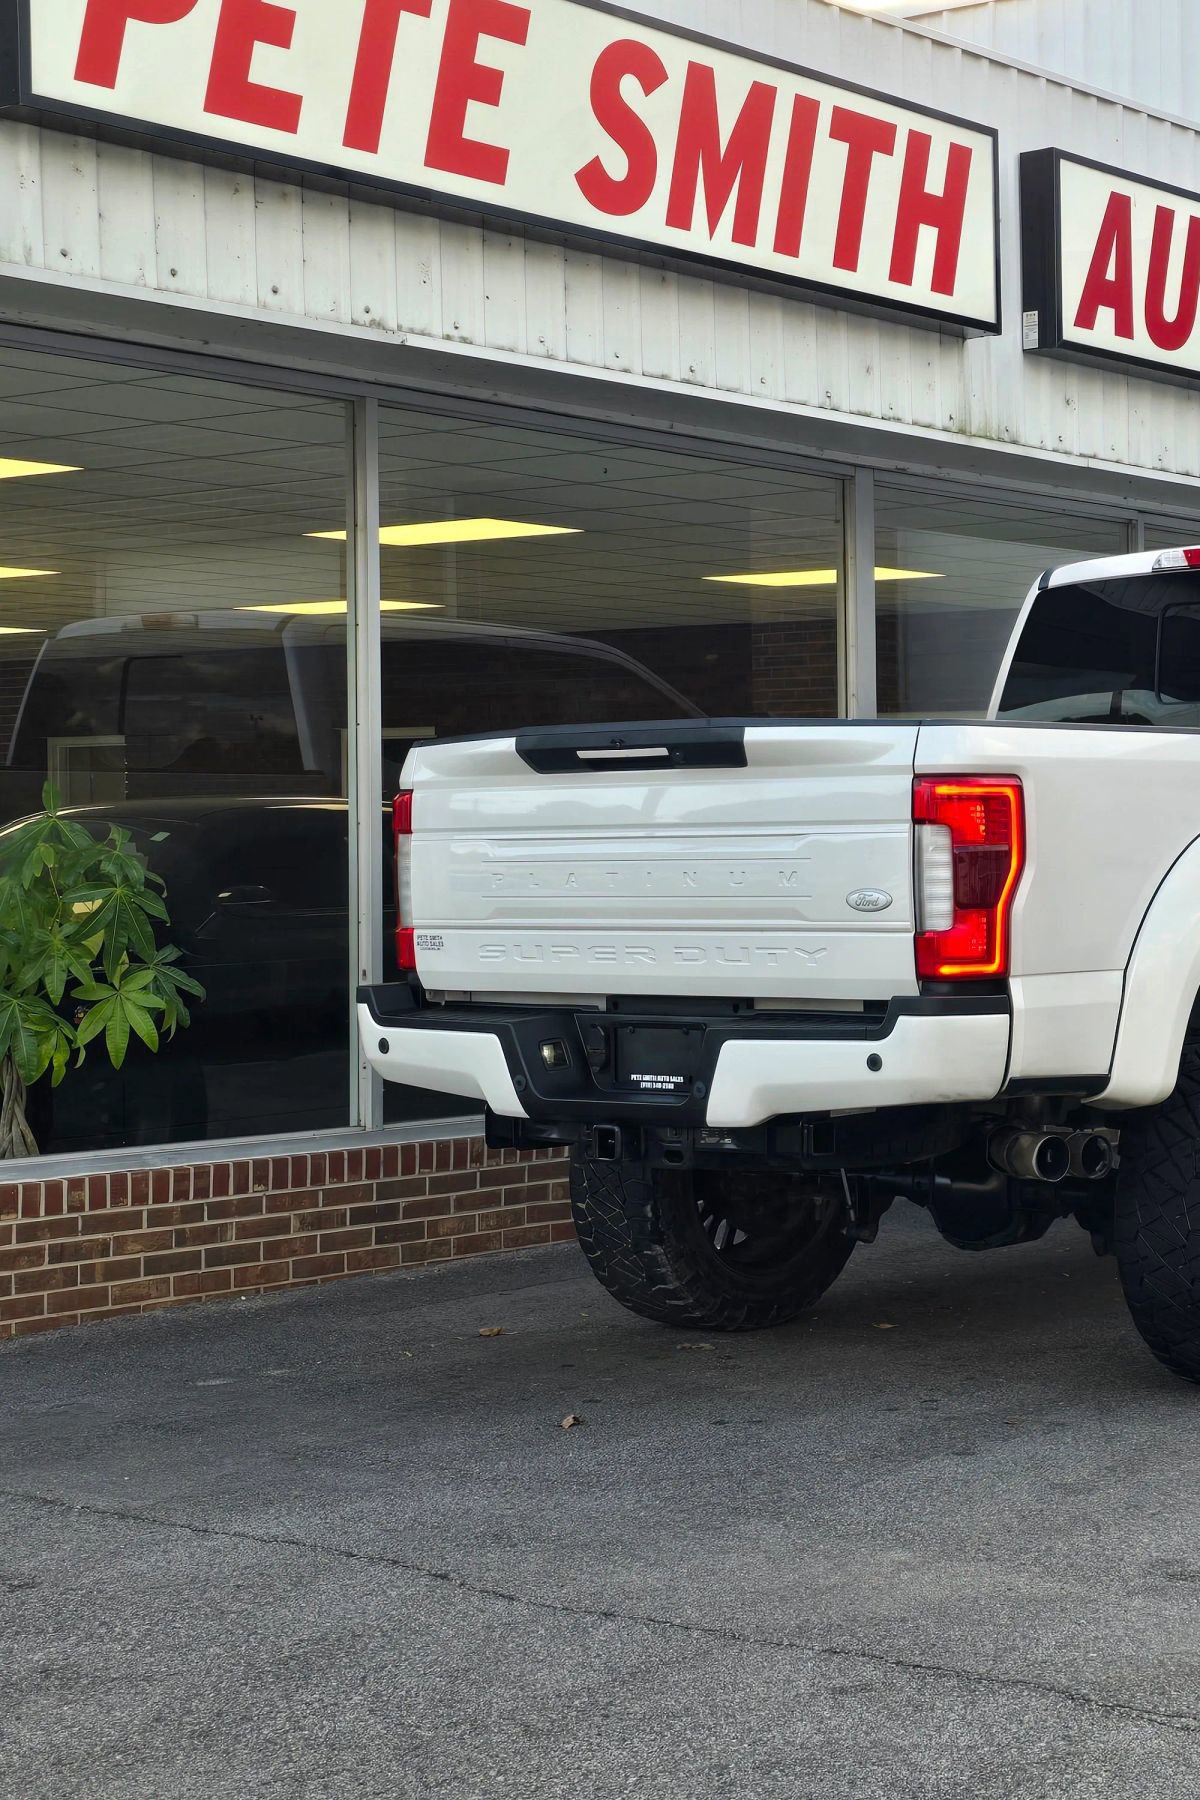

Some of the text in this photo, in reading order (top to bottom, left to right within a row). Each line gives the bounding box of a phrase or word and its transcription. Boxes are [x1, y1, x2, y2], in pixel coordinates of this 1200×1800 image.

[574, 38, 972, 296] SMITH
[490, 870, 799, 888] PLATINUM
[479, 943, 828, 967] SUPER DUTY
